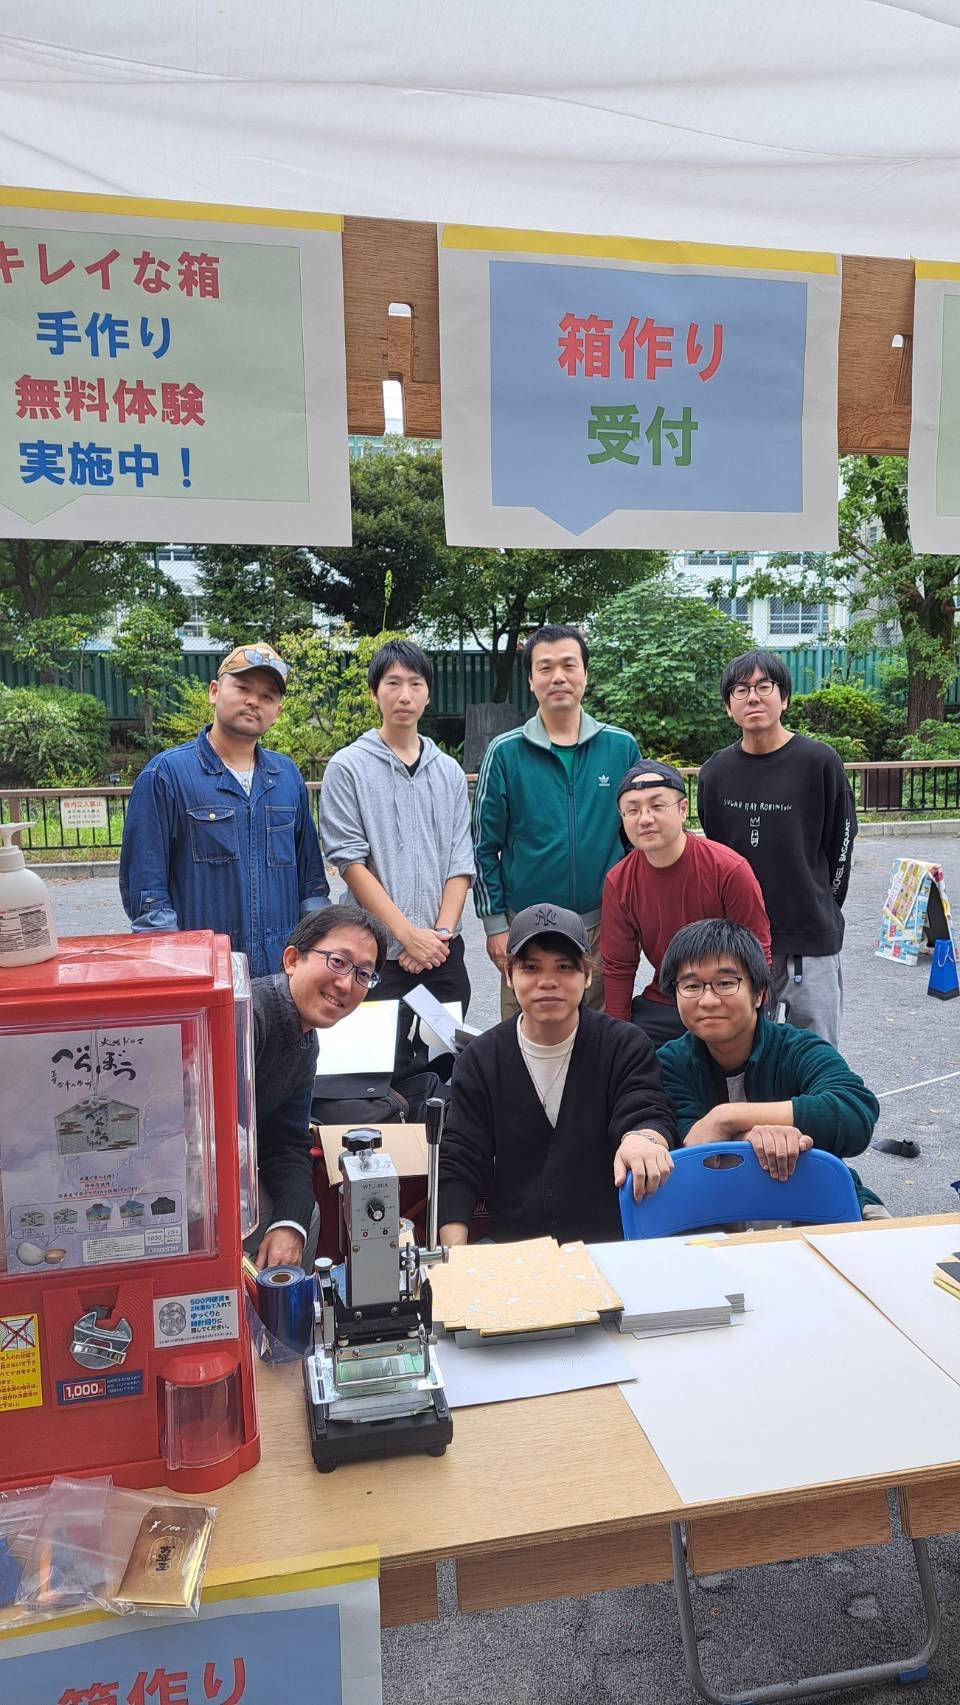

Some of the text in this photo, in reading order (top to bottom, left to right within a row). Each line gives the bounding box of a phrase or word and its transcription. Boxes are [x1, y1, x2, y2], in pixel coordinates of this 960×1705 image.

[0, 241, 220, 298] キレイな箱
[36, 310, 171, 358] 手作り
[558, 313, 723, 381] 箱作り
[15, 374, 206, 426] 無料体験
[587, 404, 698, 466] 受付
[723, 798, 743, 809] SUGAR
[191, 1311, 221, 1320] ゆっくりと
